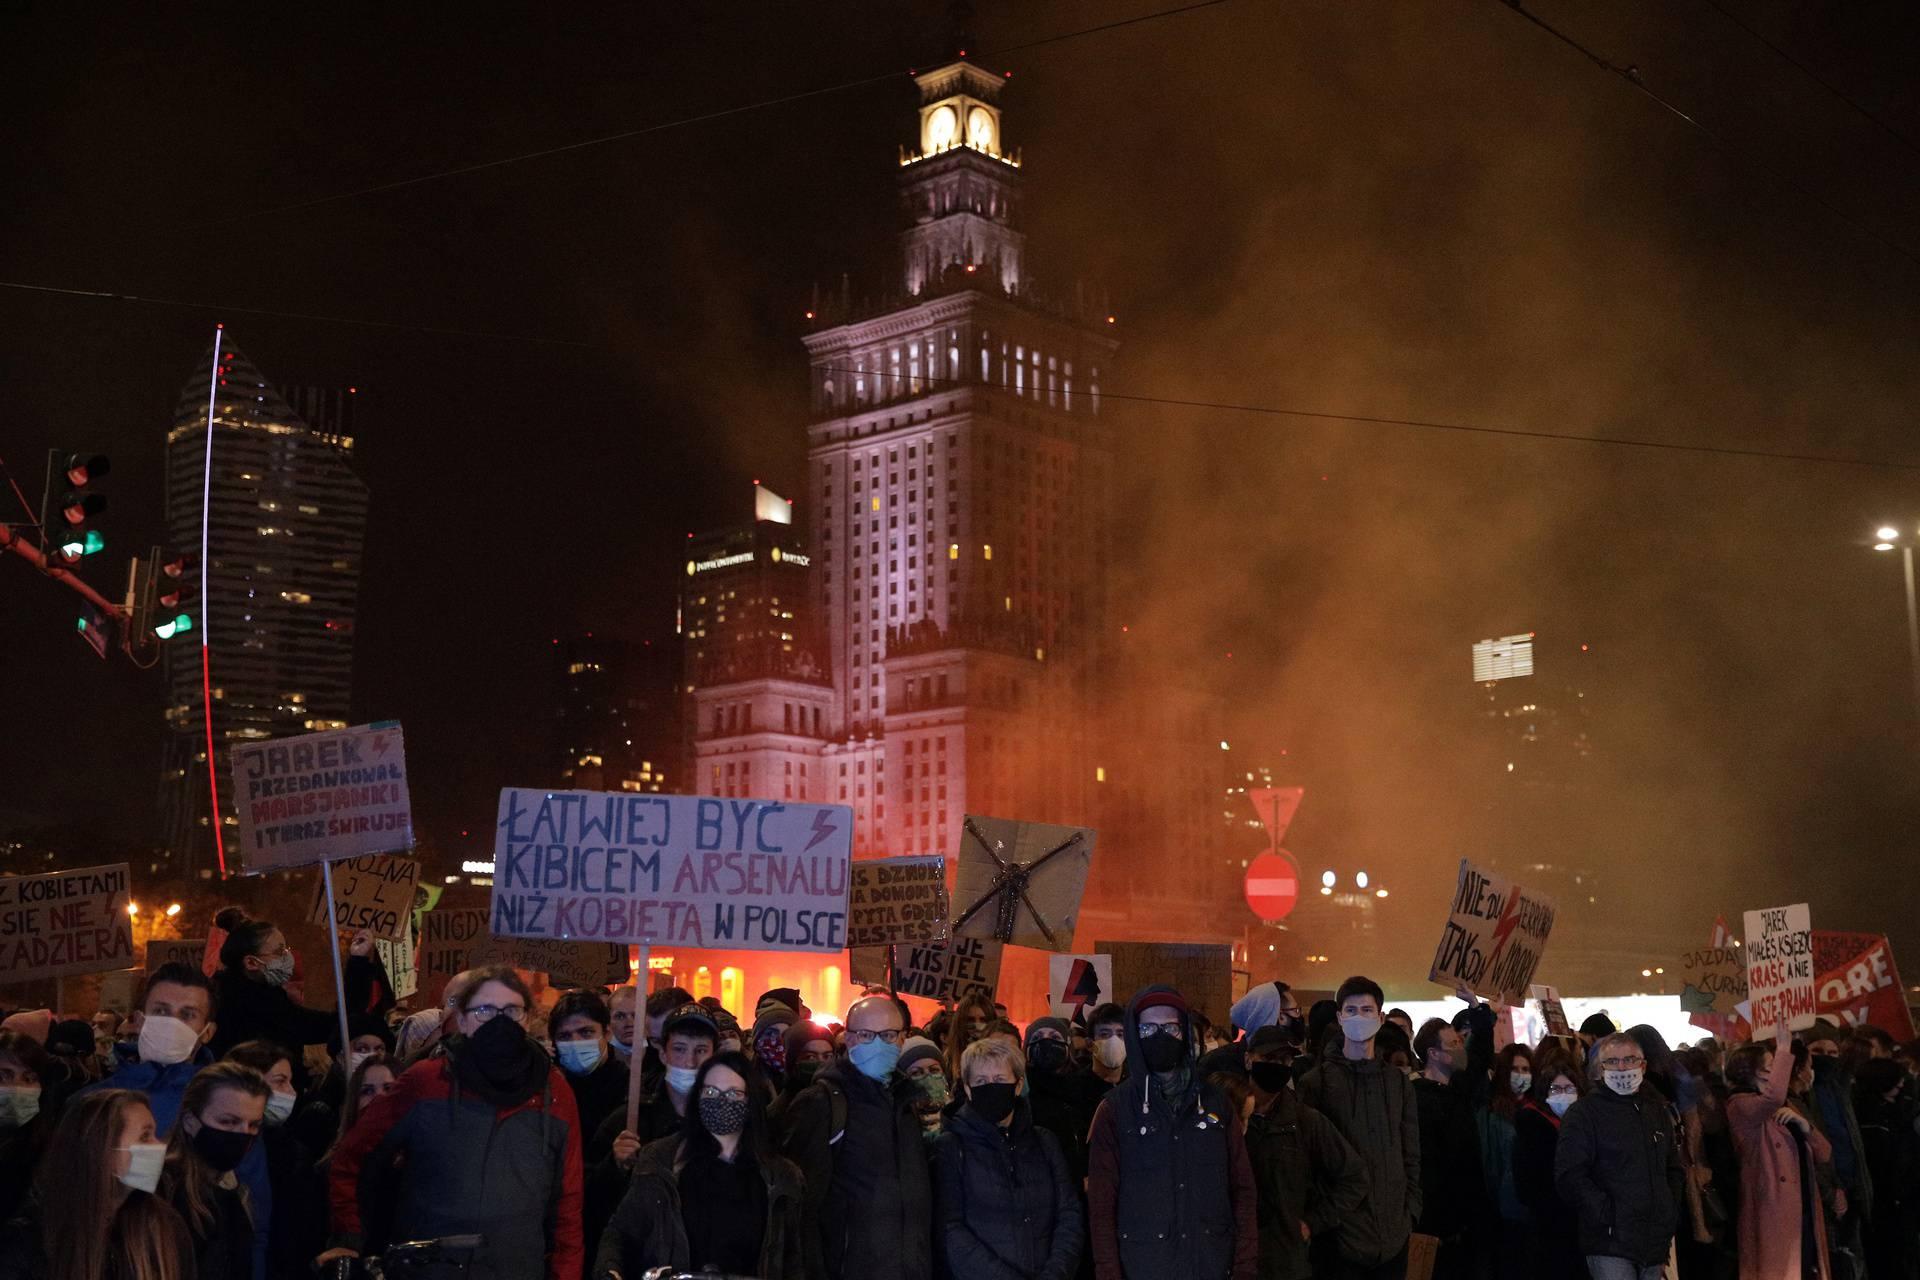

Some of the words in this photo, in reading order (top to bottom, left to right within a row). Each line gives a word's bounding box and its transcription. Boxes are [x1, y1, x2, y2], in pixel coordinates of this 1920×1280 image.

[244, 737, 362, 780] JAREK
[252, 784, 400, 825] MARSJANKI
[500, 791, 671, 847] ŁATWIEJ
[696, 799, 785, 855] BYĆ
[18, 871, 124, 904] KOBIETAMI
[504, 844, 661, 894] KIBICEM
[672, 852, 846, 897] ARSENALU
[1457, 871, 1490, 917] NIE
[3, 908, 41, 936] SIĘ
[49, 901, 95, 931] NIE
[494, 890, 547, 935] NIŻ
[554, 896, 704, 948] KOBIETA
[714, 903, 735, 940] W
[743, 904, 845, 949] POLSCE
[1761, 910, 1789, 940] JAREK
[1439, 921, 1479, 980] TAK
[1751, 995, 1778, 1033] NASZE
[1779, 985, 1815, 1028] PRAWA
